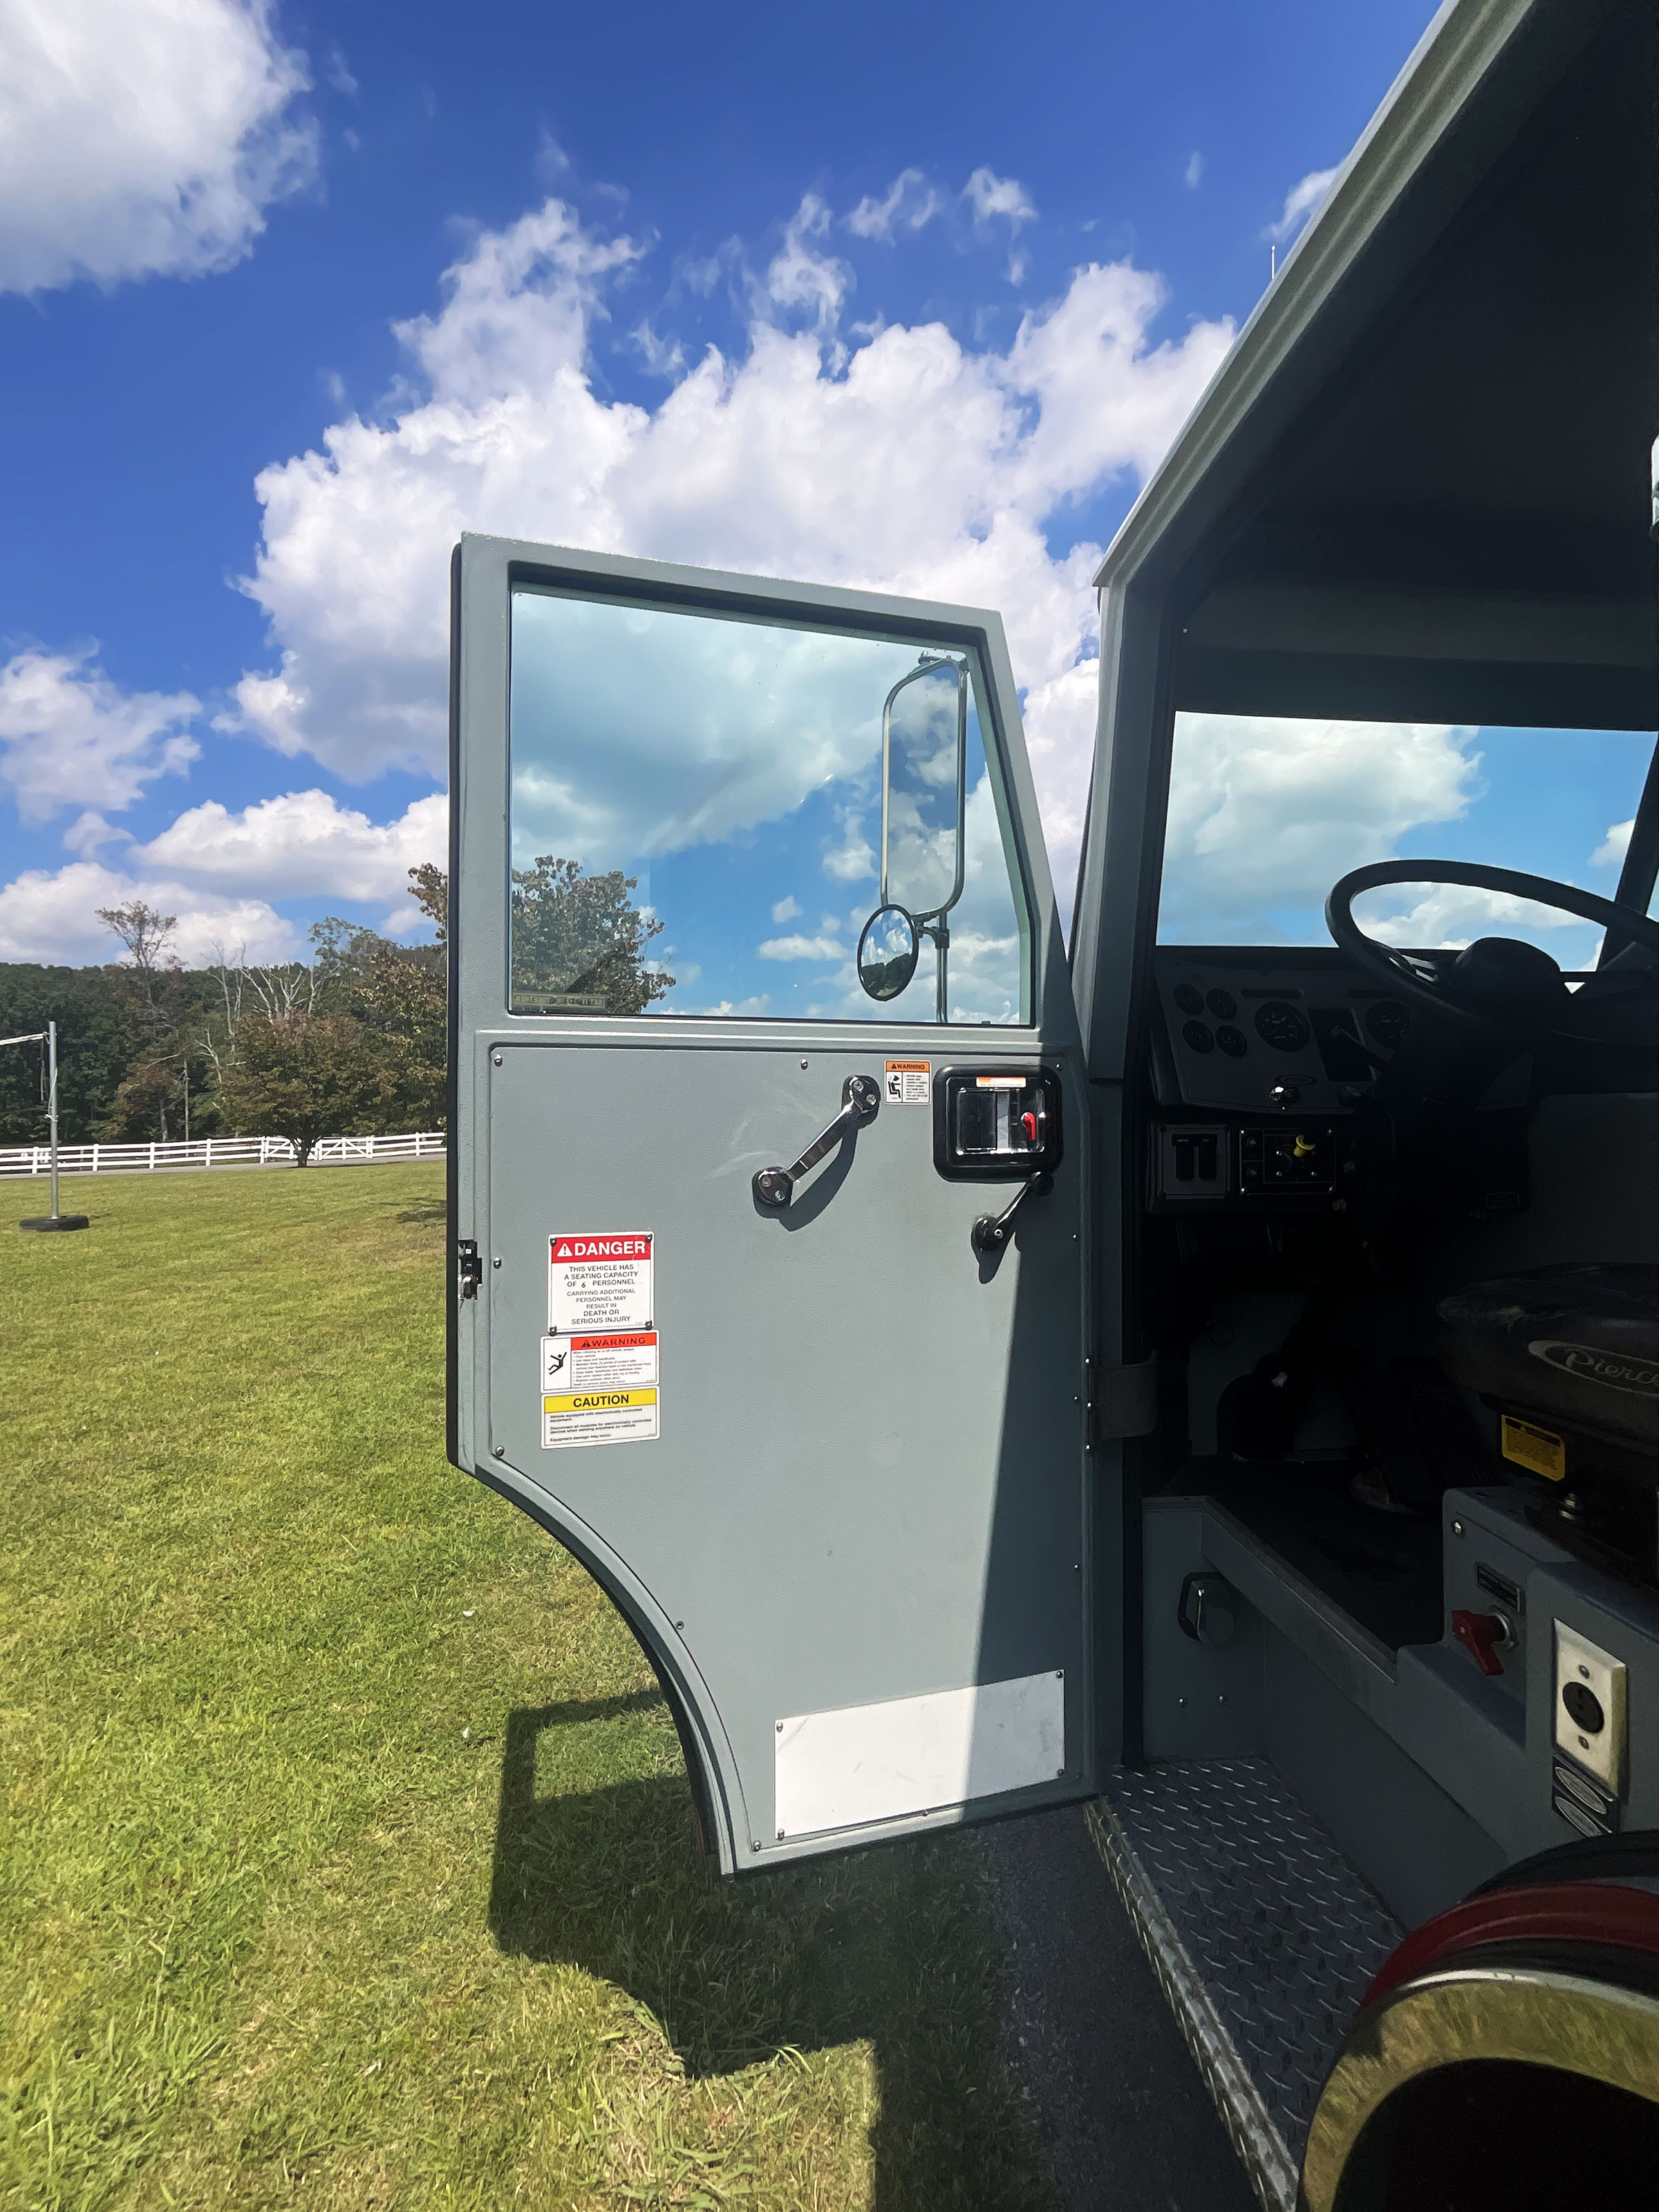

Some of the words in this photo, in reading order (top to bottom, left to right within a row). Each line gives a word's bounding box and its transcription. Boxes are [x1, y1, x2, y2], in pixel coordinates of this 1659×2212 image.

[575, 1241, 646, 1256] DANGER
[592, 1337, 646, 1347] WARNING
[573, 1394, 629, 1407] CAUTION
